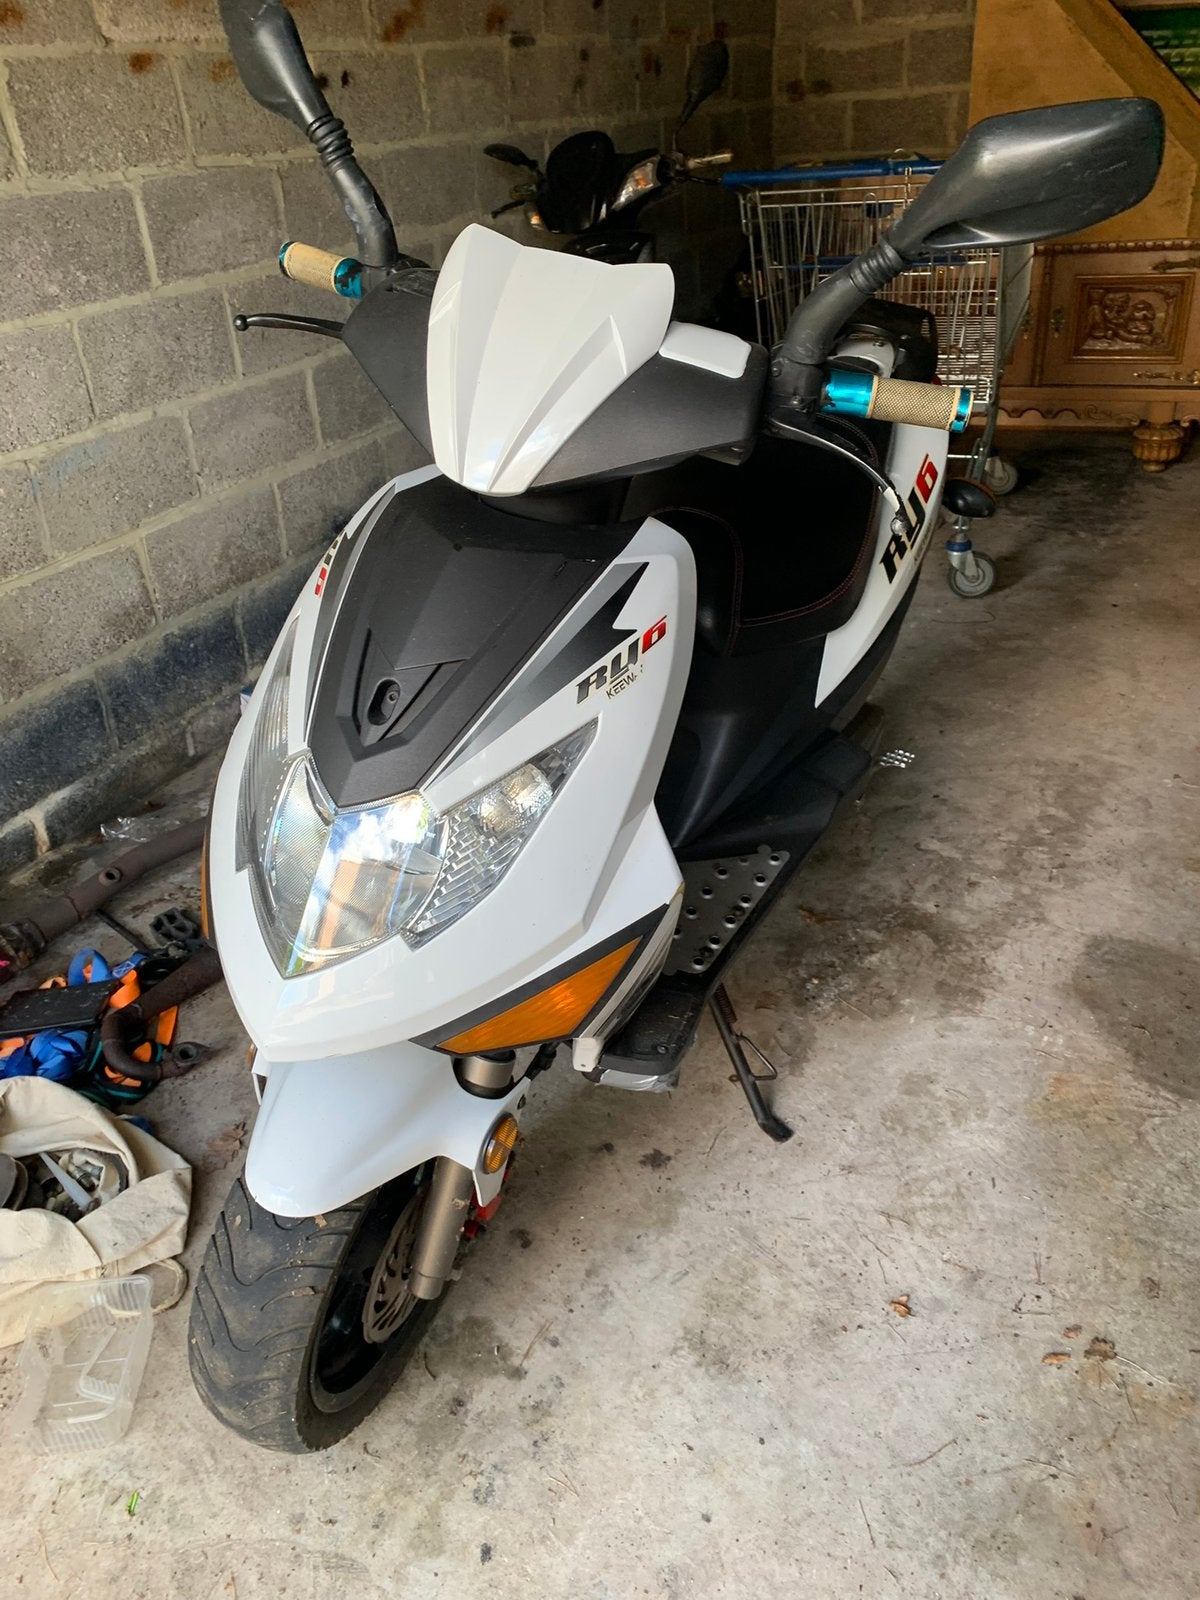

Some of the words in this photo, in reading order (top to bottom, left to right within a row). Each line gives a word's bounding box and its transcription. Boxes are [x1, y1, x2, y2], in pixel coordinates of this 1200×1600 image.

[880, 453, 938, 584] RU6
[576, 615, 667, 704] RU6
[606, 664, 643, 700] KEEW
